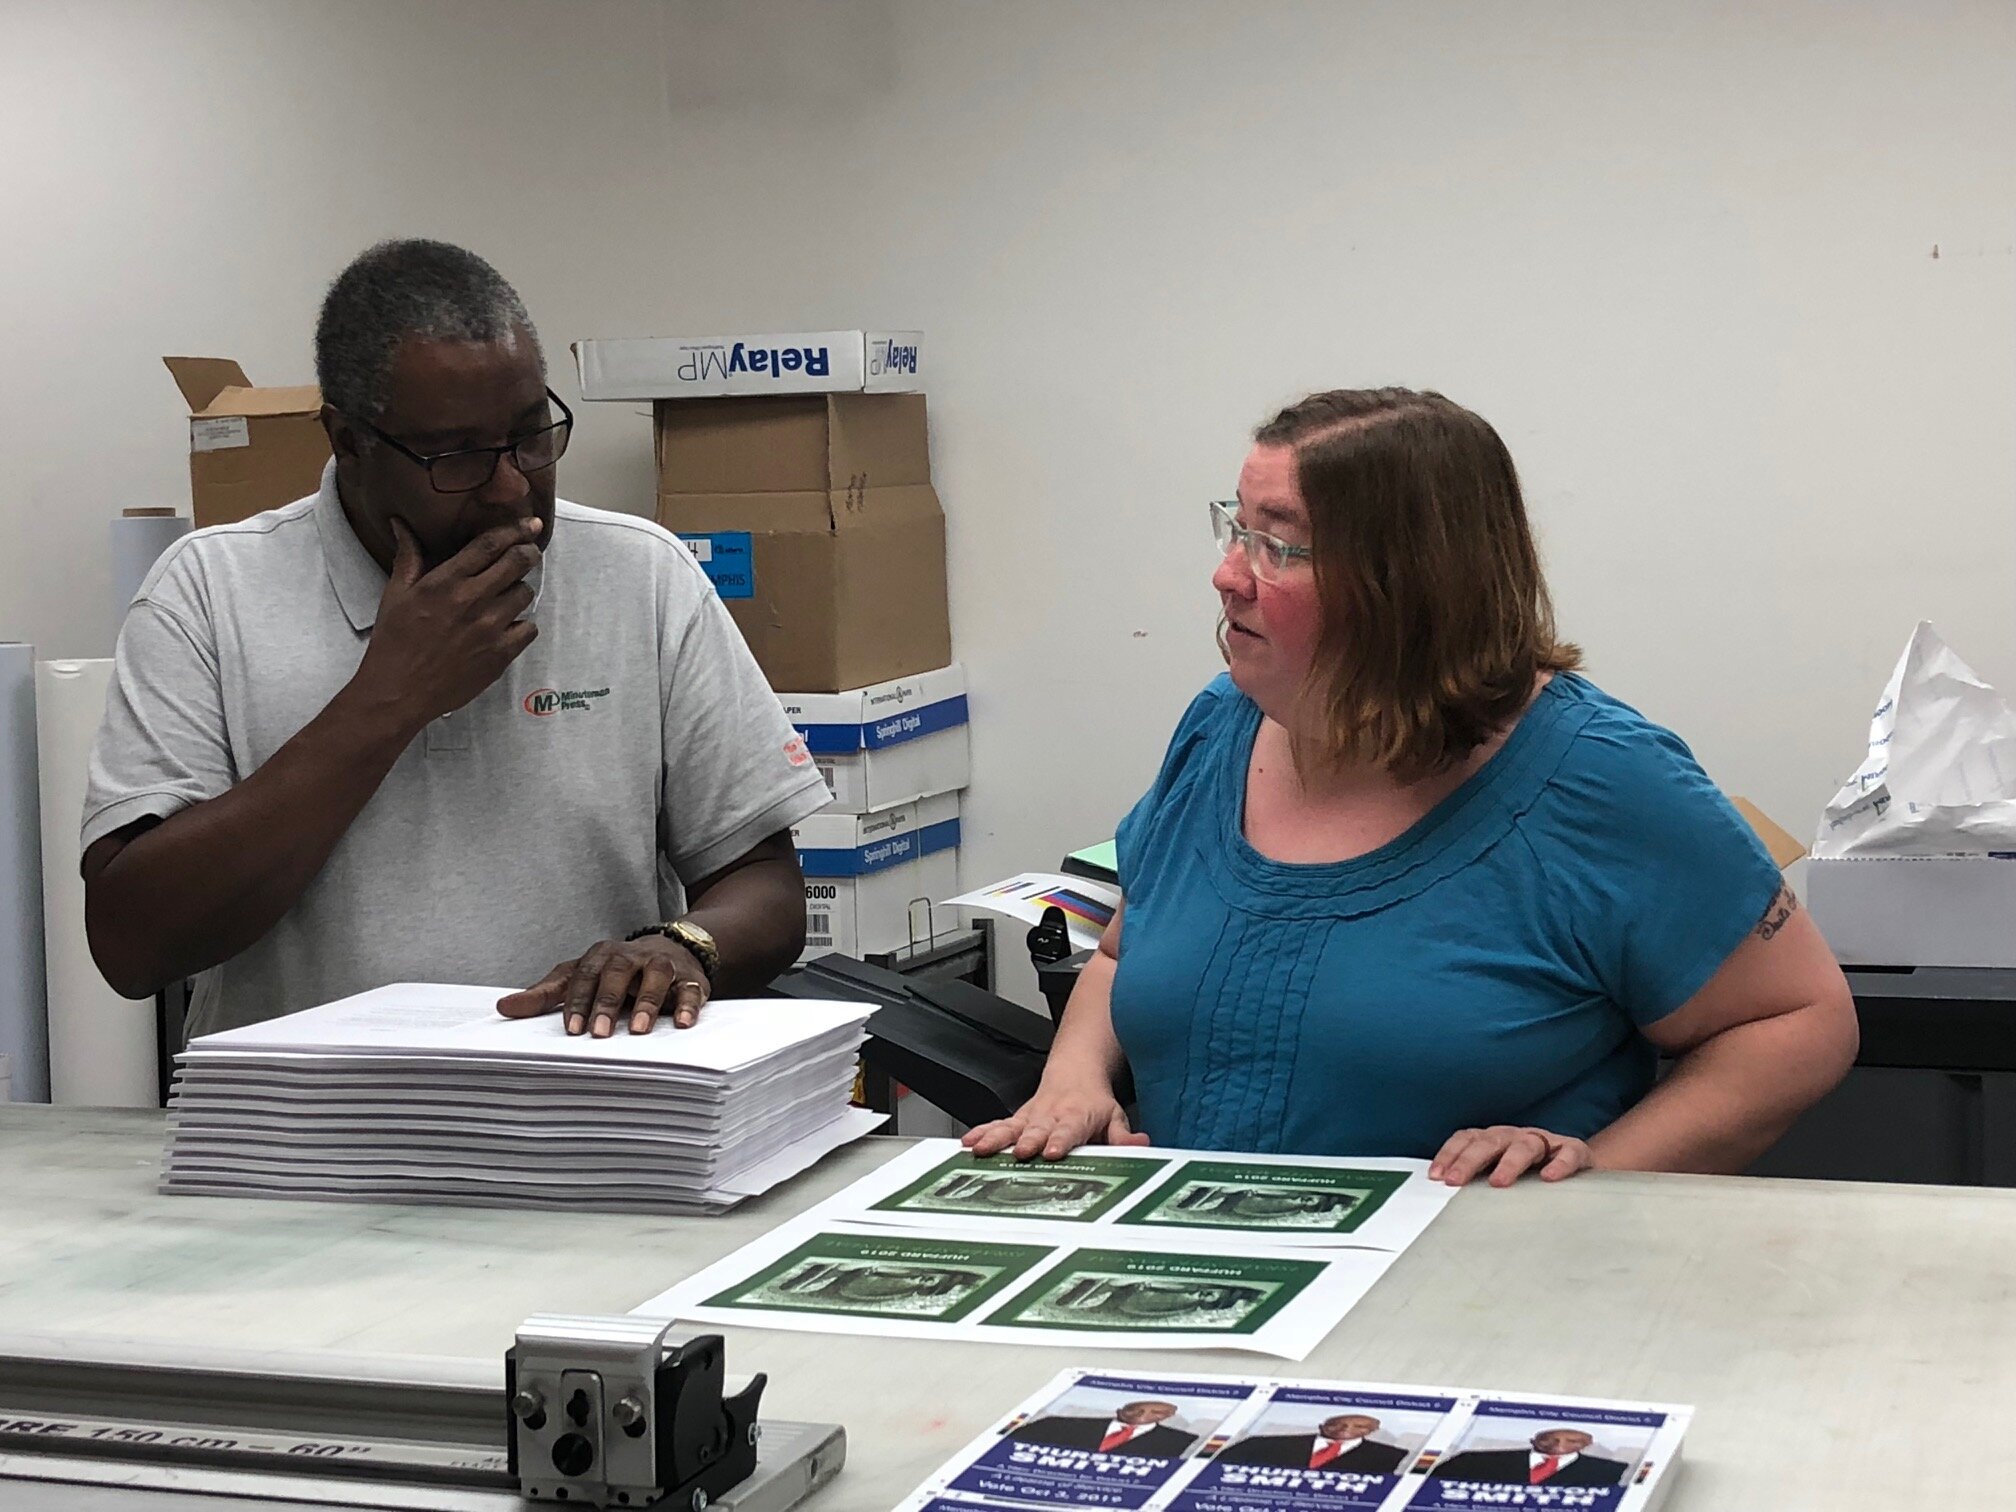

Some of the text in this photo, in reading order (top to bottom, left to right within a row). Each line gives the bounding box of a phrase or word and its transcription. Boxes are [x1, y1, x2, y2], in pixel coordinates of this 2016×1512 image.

[561, 700, 586, 711] Press
[876, 713, 921, 741] Springhill Digital
[864, 837, 910, 865] Springhill Digital
[805, 885, 837, 899] 6000
[91, 1427, 163, 1443] 150
[170, 1436, 238, 1449] cm
[1009, 1451, 1153, 1477] SMITH
[1013, 1441, 1169, 1469] THURSTON
[1220, 1472, 1368, 1494] SMITH
[1221, 1463, 1384, 1485] THURSTON
[979, 1480, 1015, 1492] Vote
[1021, 1486, 1050, 1497] Oct
[1439, 1480, 1611, 1496] THURSTON
[1440, 1489, 1596, 1506] SMITH
